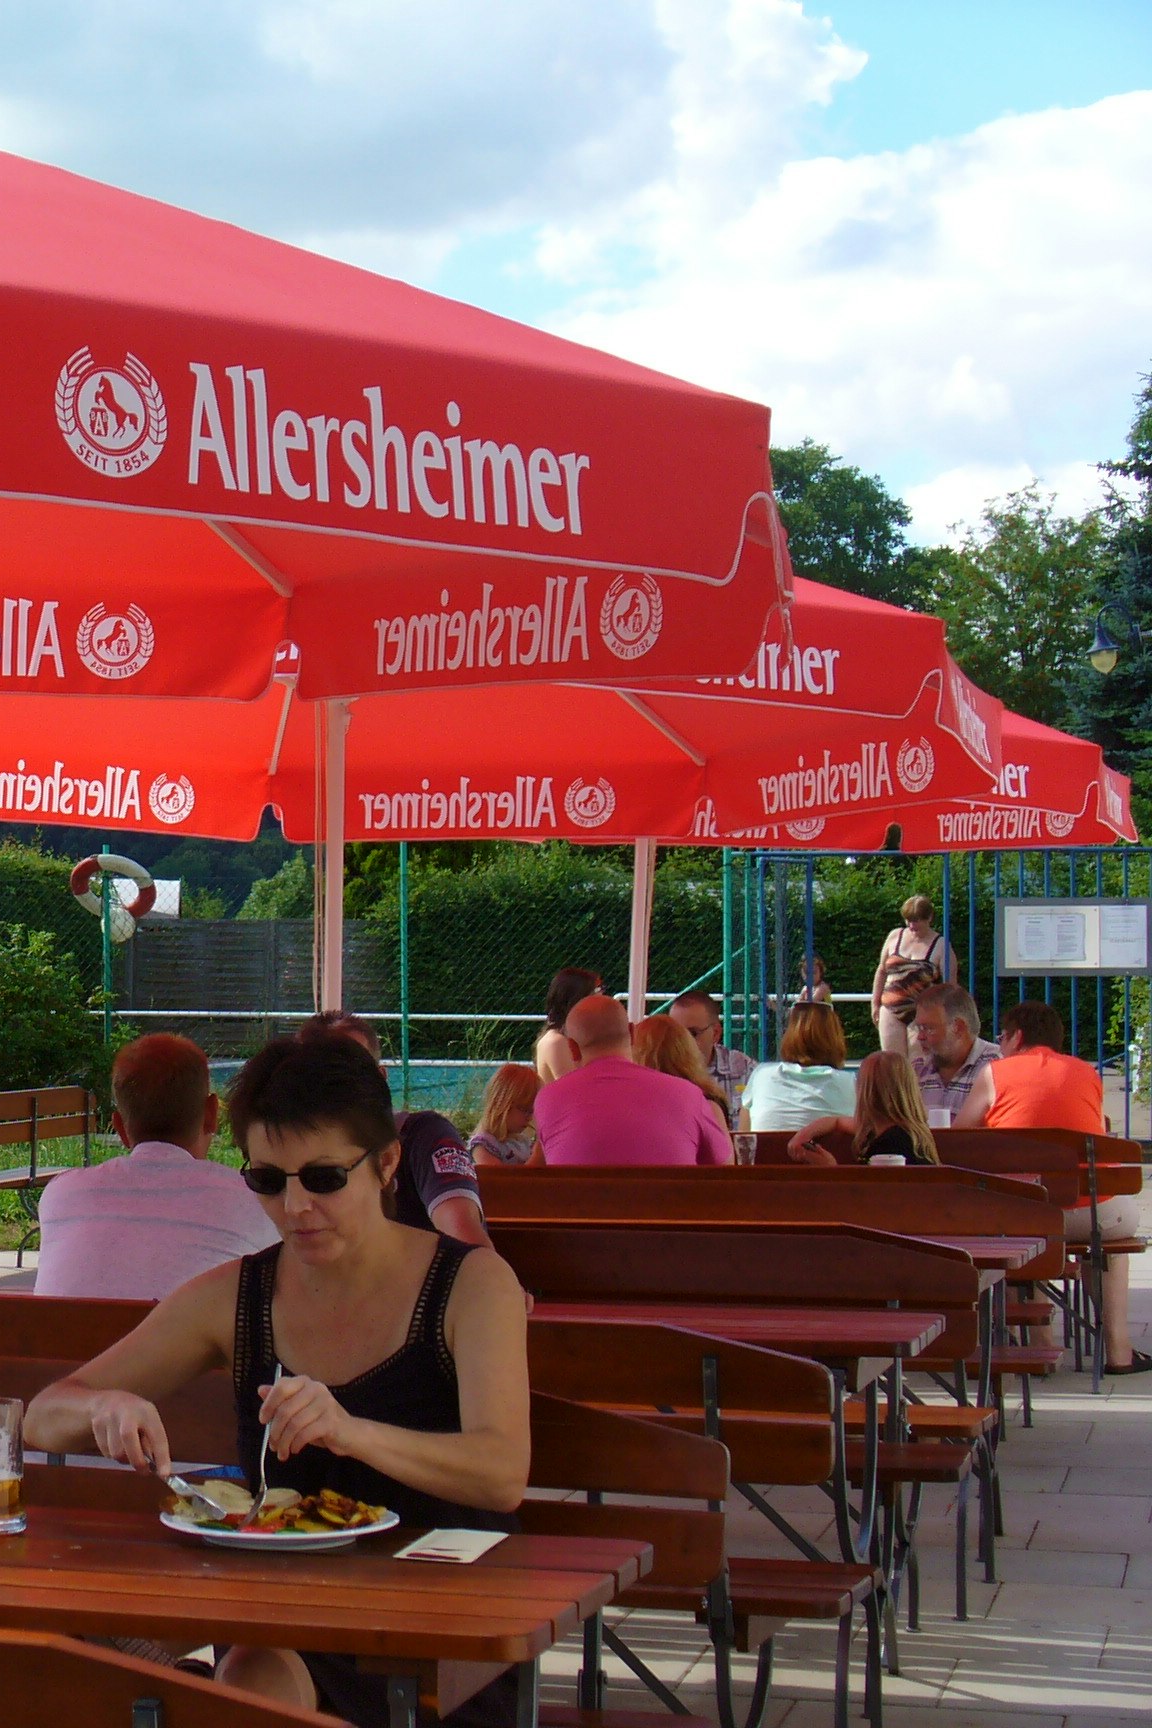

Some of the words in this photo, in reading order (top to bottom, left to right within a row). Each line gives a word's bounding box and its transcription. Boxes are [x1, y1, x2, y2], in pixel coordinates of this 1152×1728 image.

[75, 443, 108, 471] SEIT
[114, 449, 150, 473] 1854
[188, 360, 591, 537] Allersheimer
